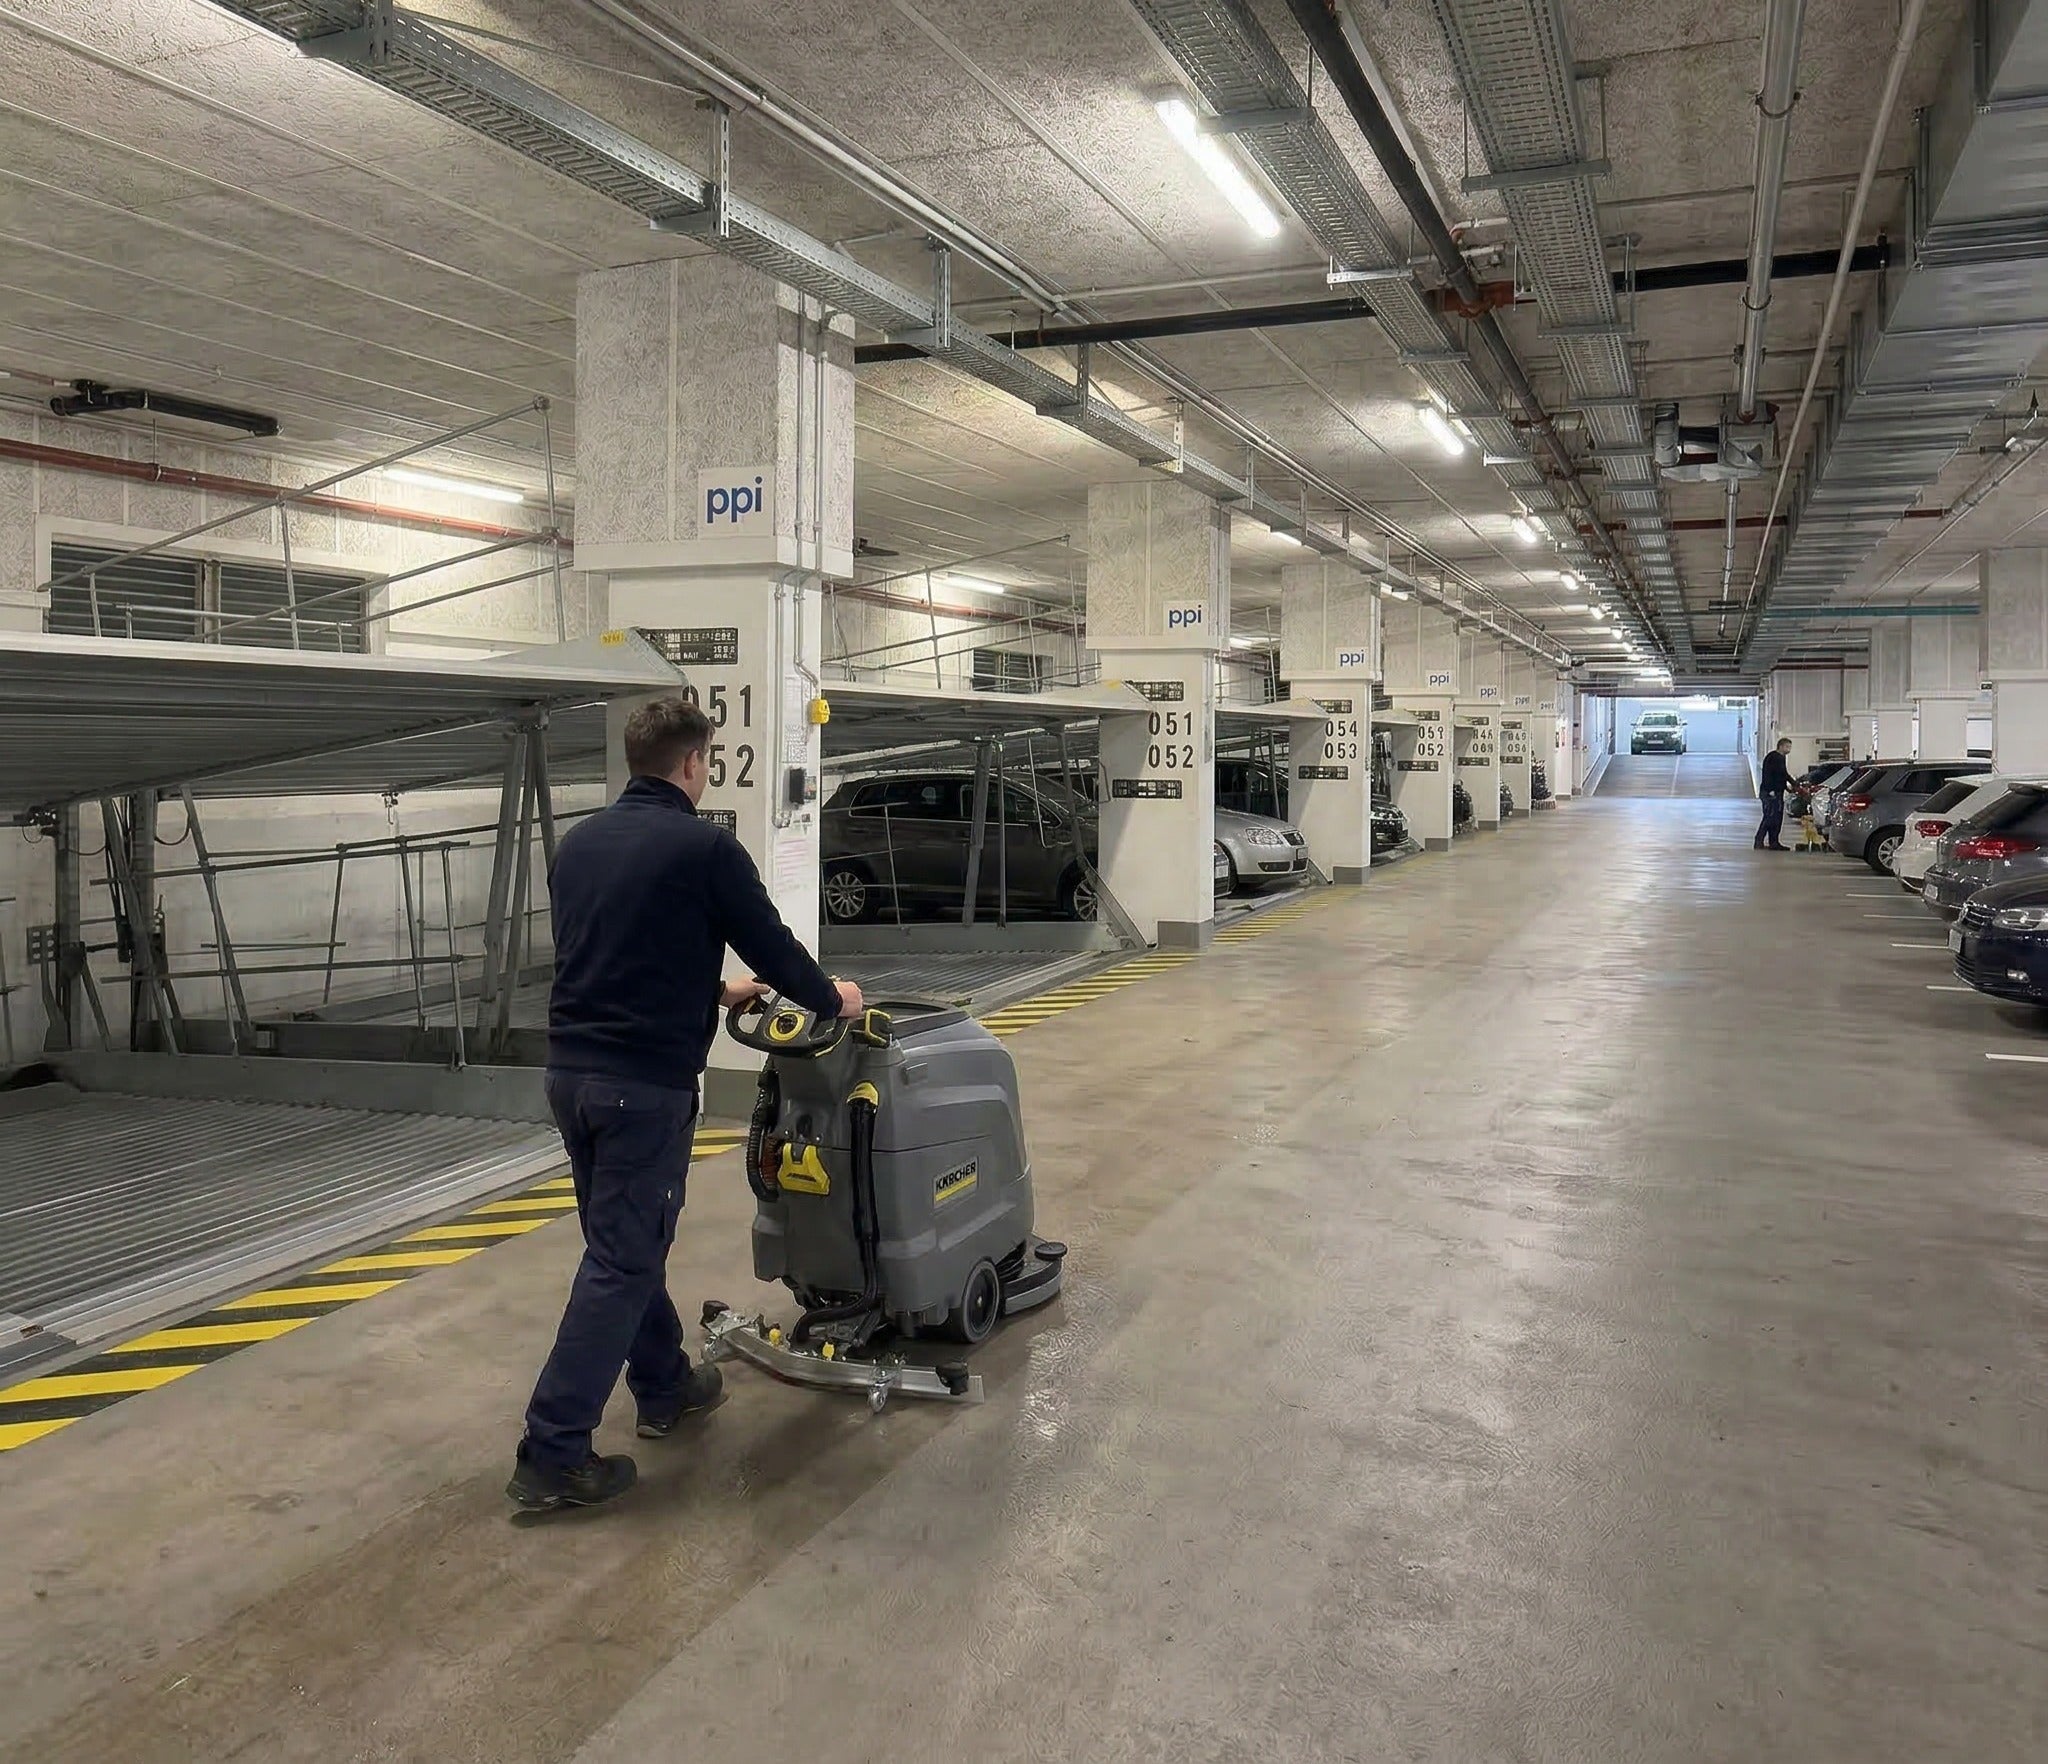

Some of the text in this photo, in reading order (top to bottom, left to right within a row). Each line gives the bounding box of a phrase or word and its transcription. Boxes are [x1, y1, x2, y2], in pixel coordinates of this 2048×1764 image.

[706, 476, 763, 524] ppi
[1169, 604, 1202, 628] ppi
[1340, 649, 1365, 667] ppi
[1429, 671, 1450, 686] ppi
[1148, 712, 1192, 736] 051
[1325, 720, 1357, 737] 054
[1148, 744, 1194, 769] 052
[1324, 742, 1357, 759] 053
[1417, 742, 1444, 757] 052
